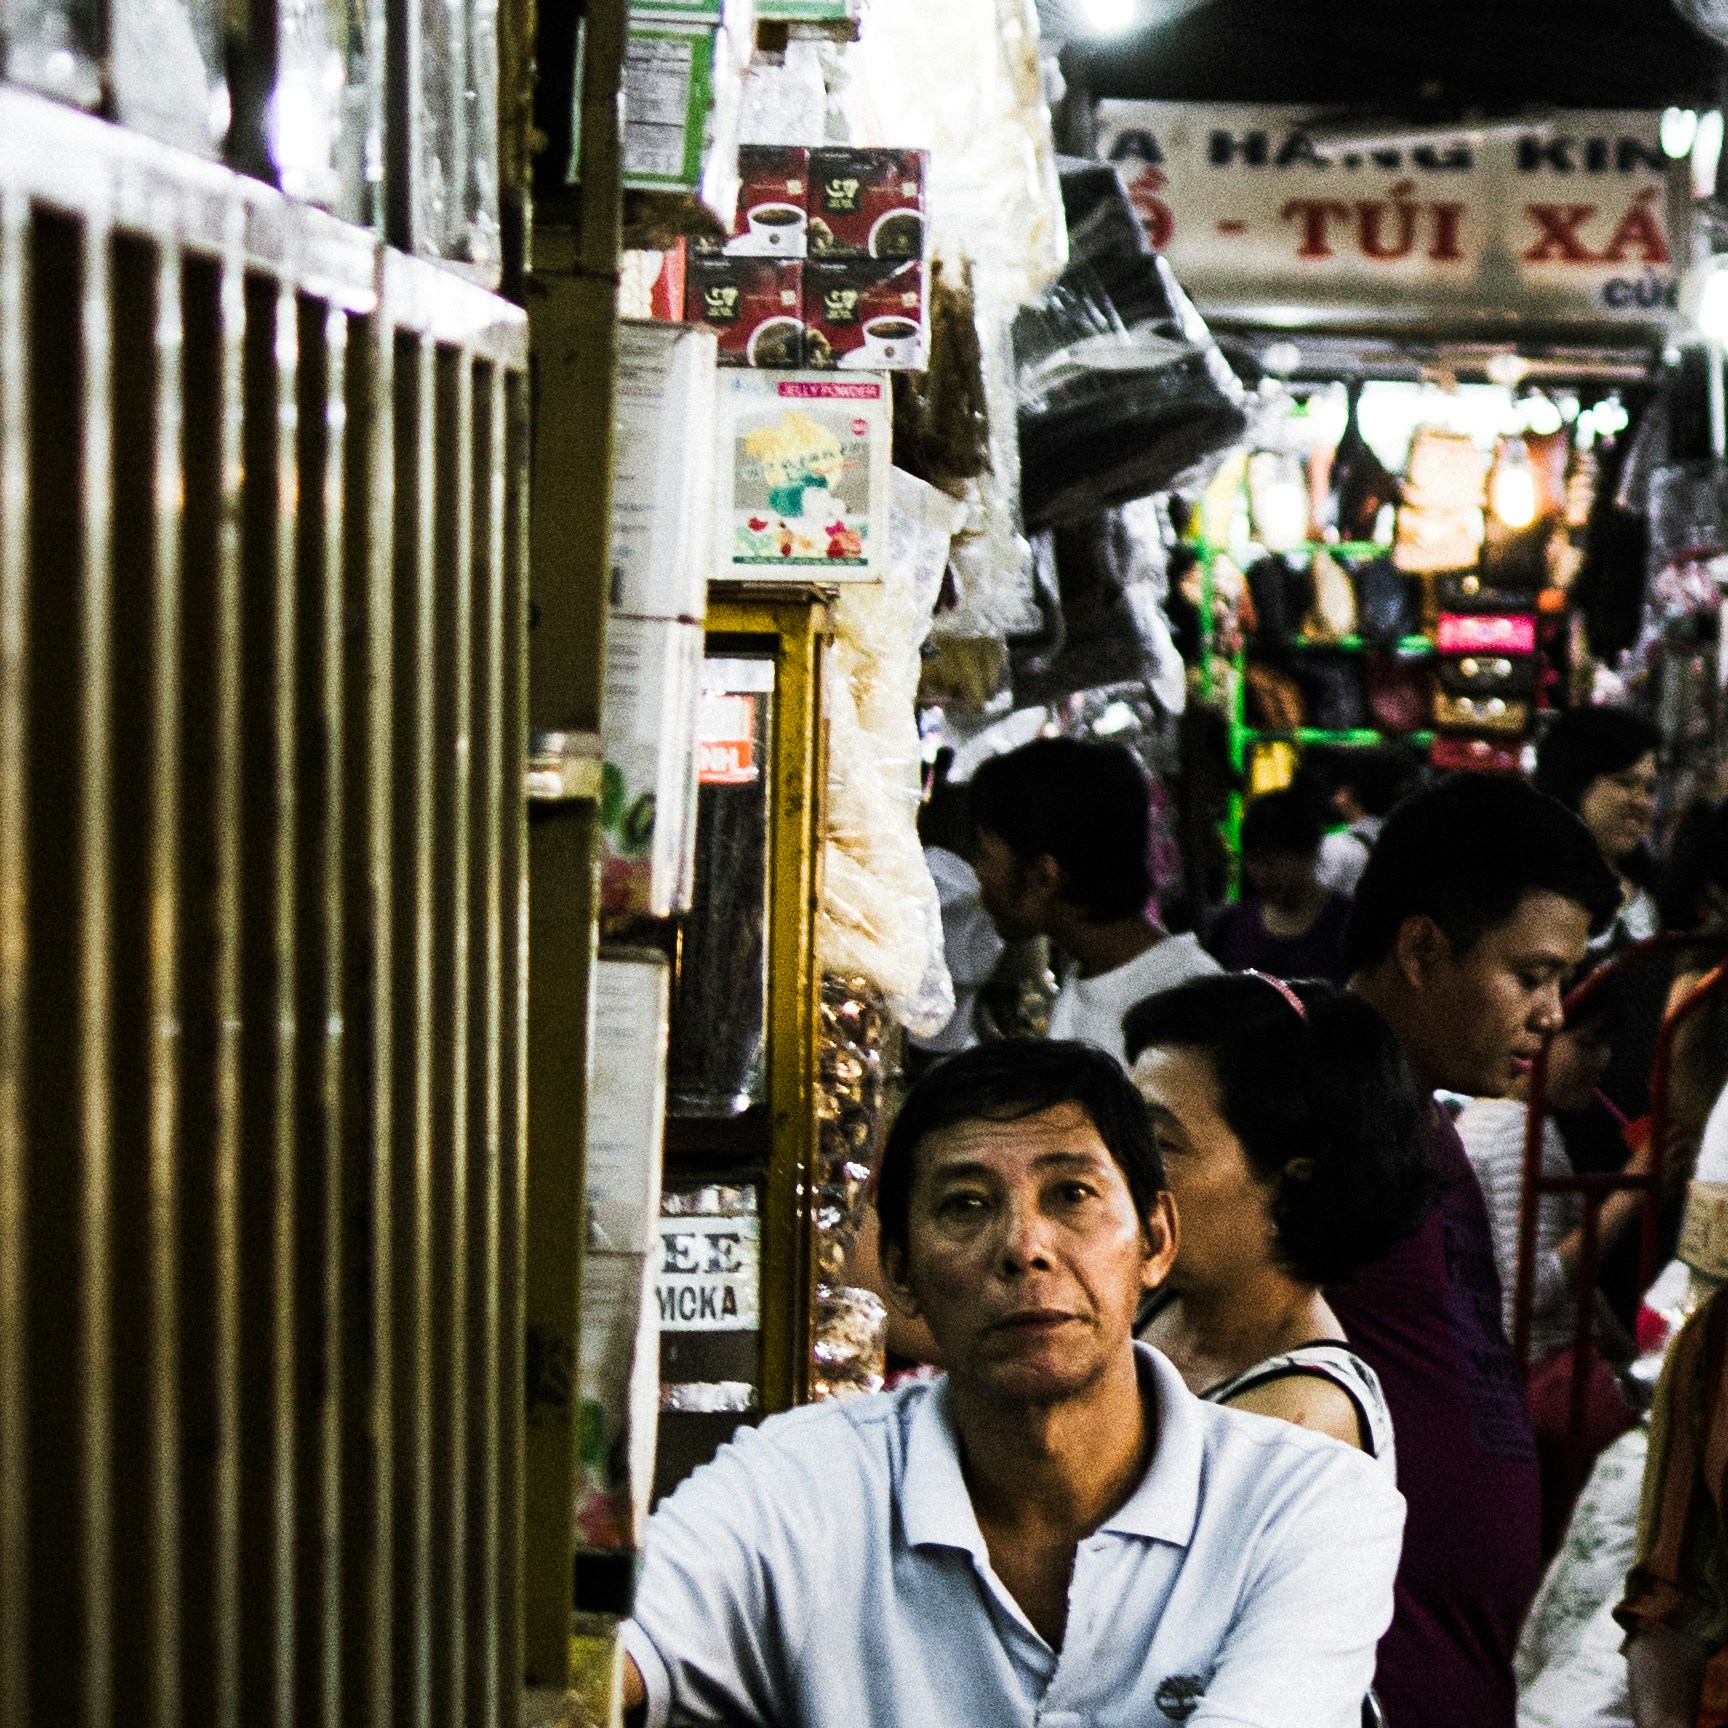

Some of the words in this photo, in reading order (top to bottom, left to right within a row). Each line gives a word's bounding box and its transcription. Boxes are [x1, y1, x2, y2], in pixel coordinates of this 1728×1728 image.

[1280, 180, 1467, 262] TÚI
[1522, 186, 1670, 266] XÁ
[783, 383, 822, 397] JELLY
[823, 384, 879, 398] POWDER
